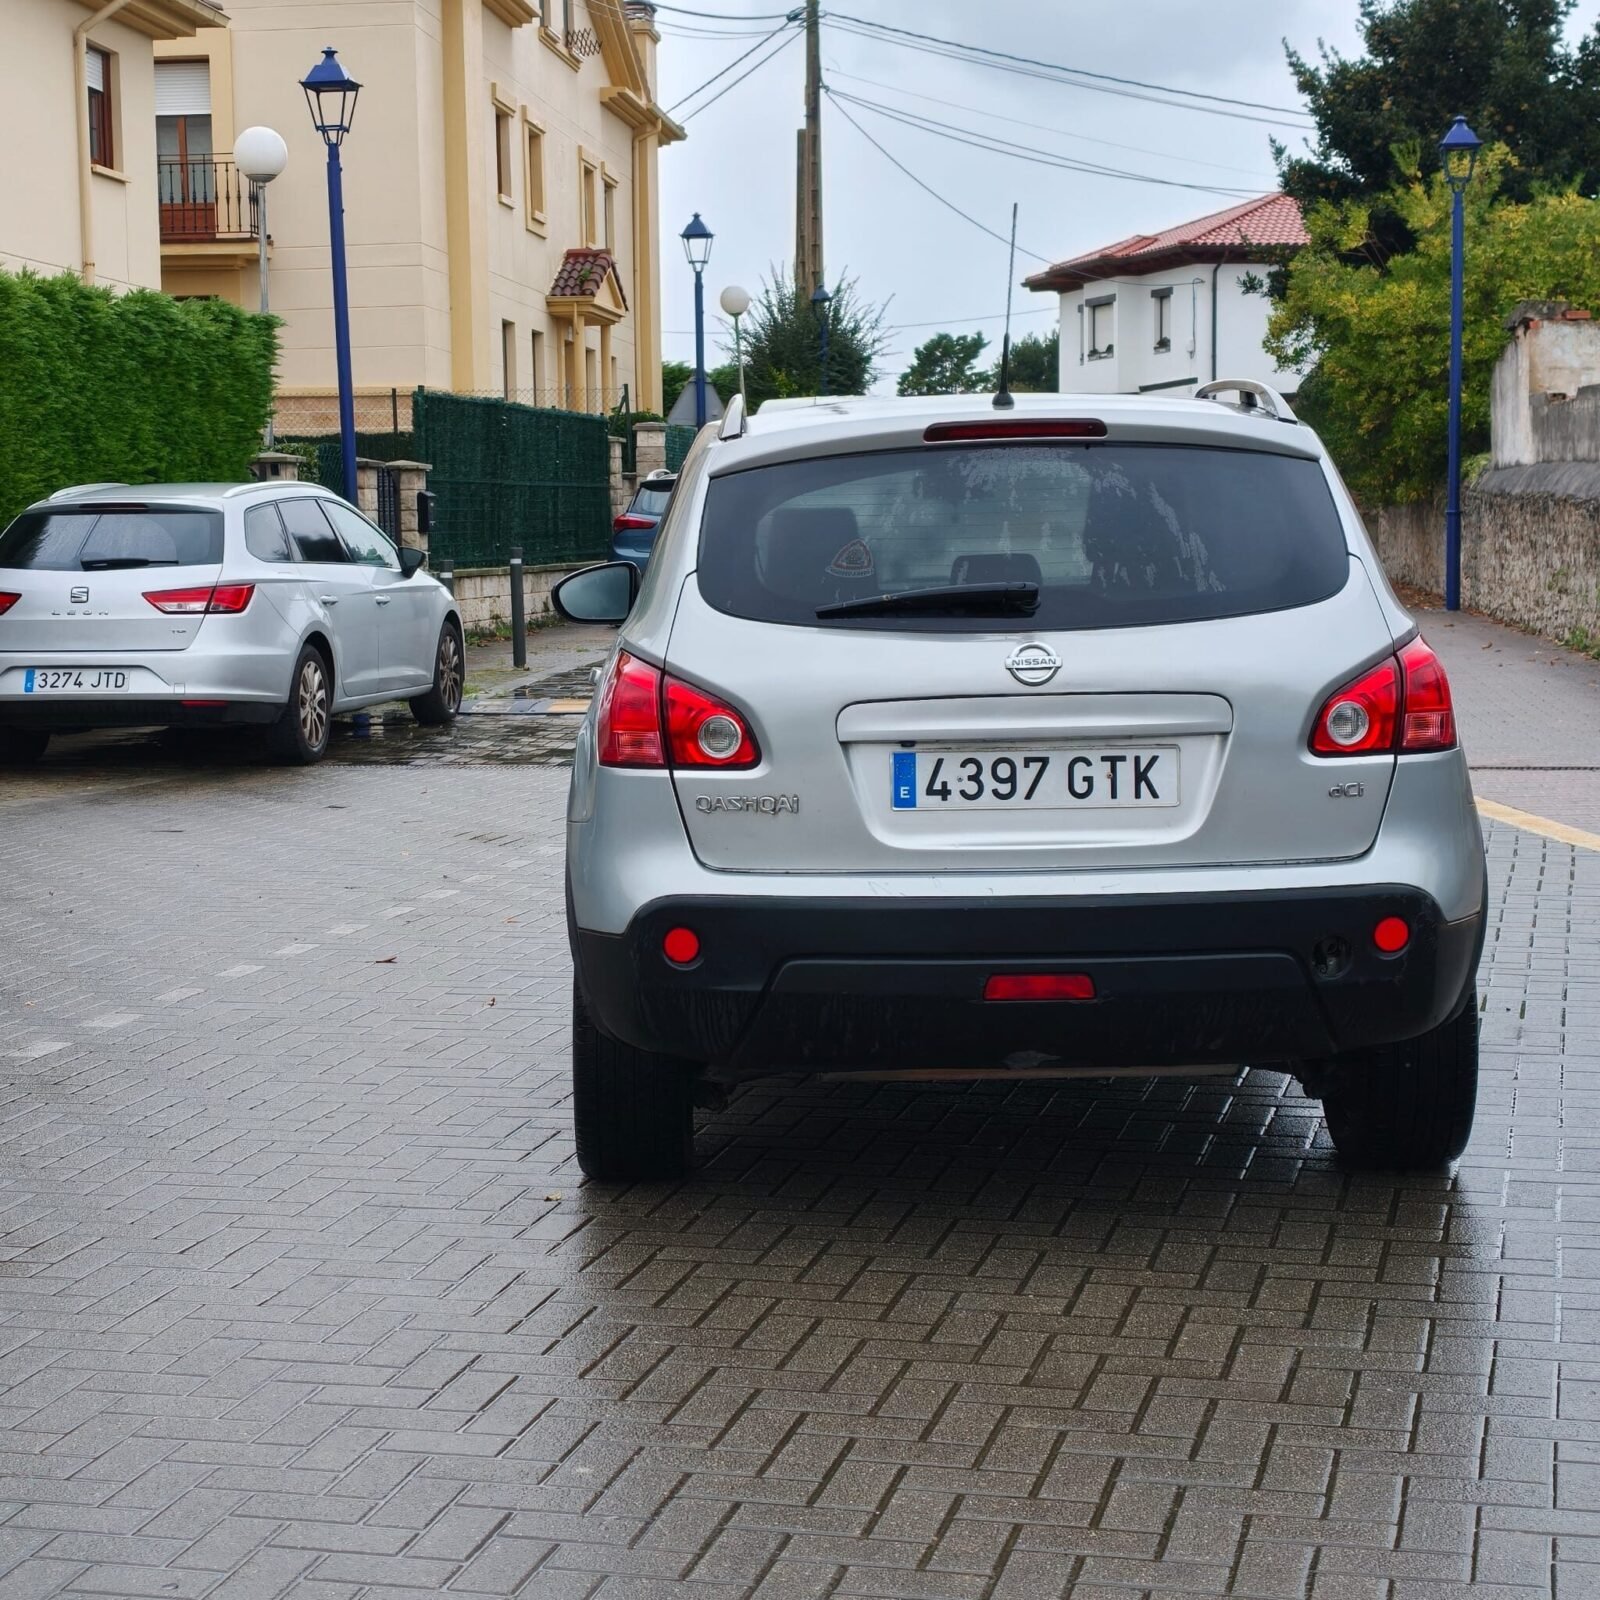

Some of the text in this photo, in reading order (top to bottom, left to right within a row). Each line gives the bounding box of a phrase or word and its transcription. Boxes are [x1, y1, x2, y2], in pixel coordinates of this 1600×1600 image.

[1011, 658, 1057, 666] NISSAN
[38, 672, 126, 688] 3274 JTD
[900, 755, 1160, 801] E 4397 GTK
